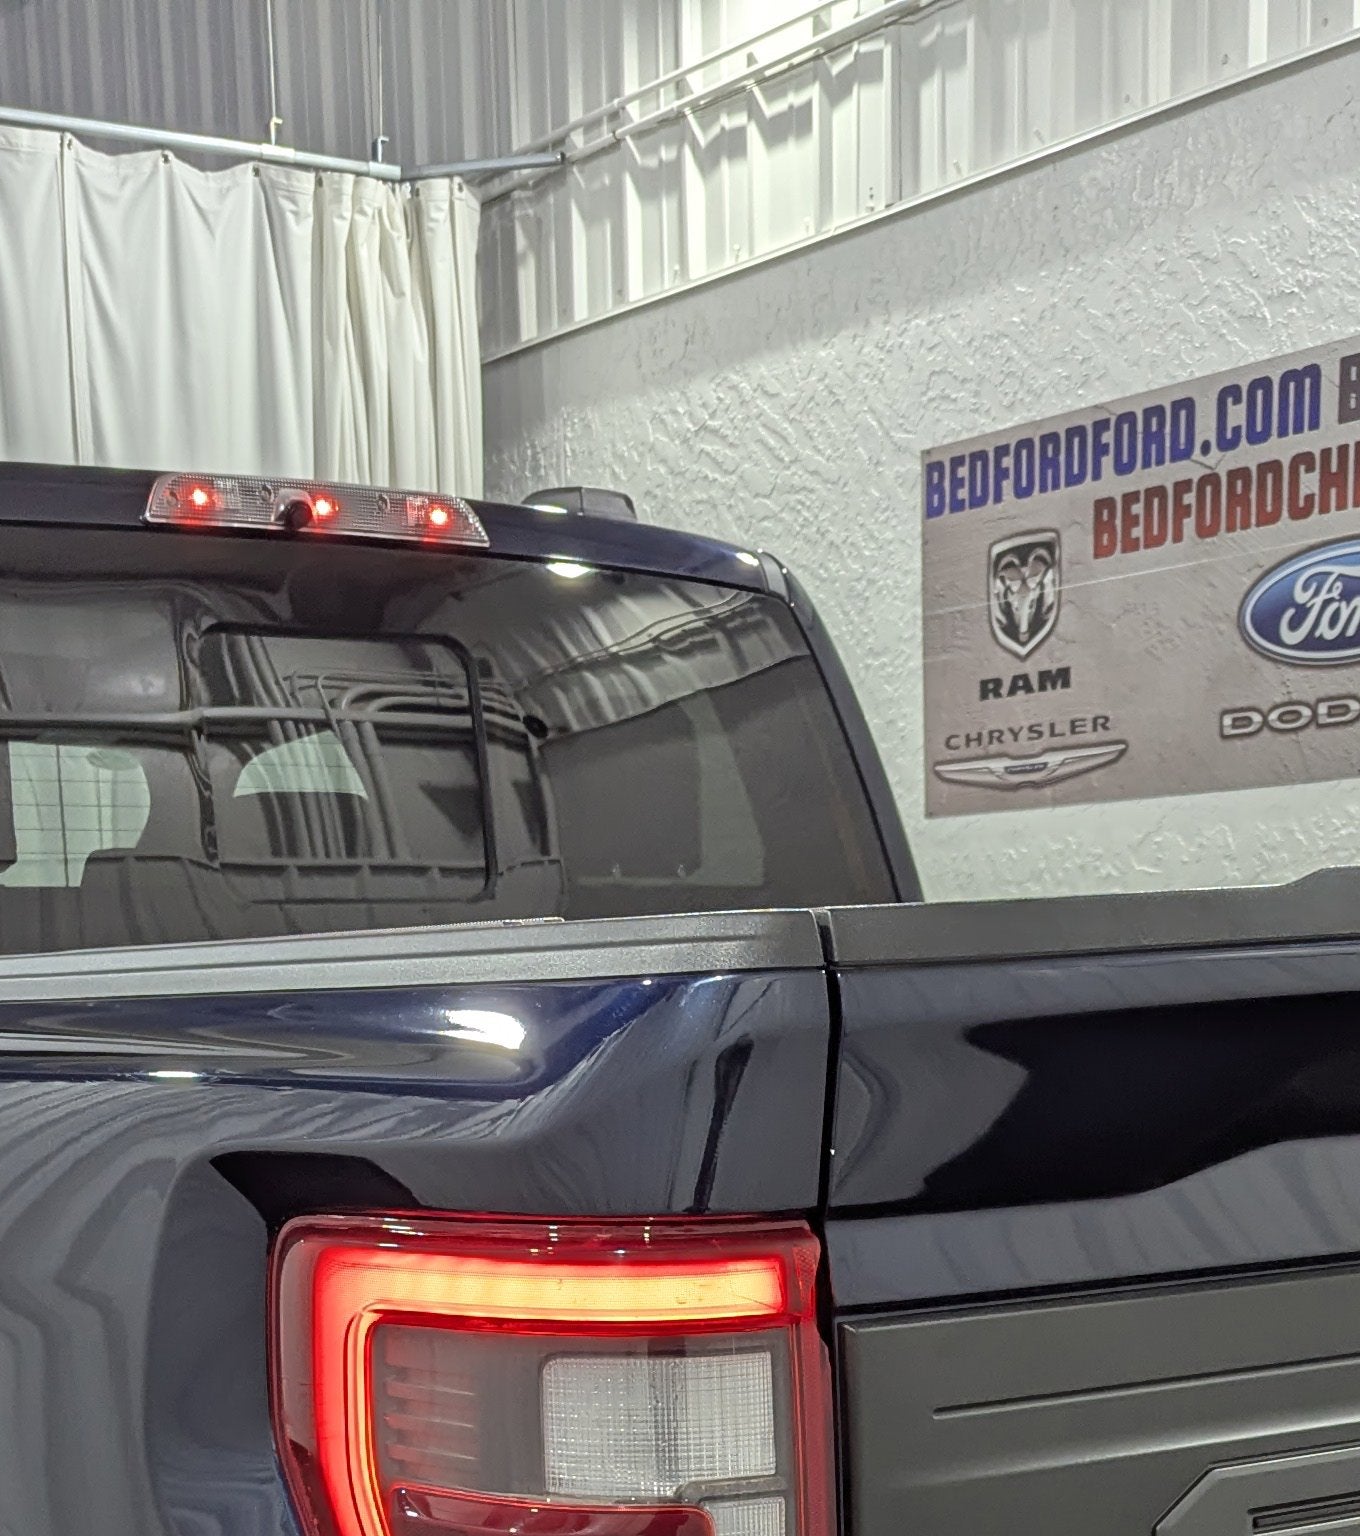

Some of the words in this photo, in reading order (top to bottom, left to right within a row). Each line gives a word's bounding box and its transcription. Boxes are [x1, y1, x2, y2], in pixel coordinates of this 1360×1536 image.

[925, 363, 1322, 520] BEDFORDFORD.COM
[978, 666, 1072, 702] RAM
[944, 714, 1112, 751] CHRYSLER
